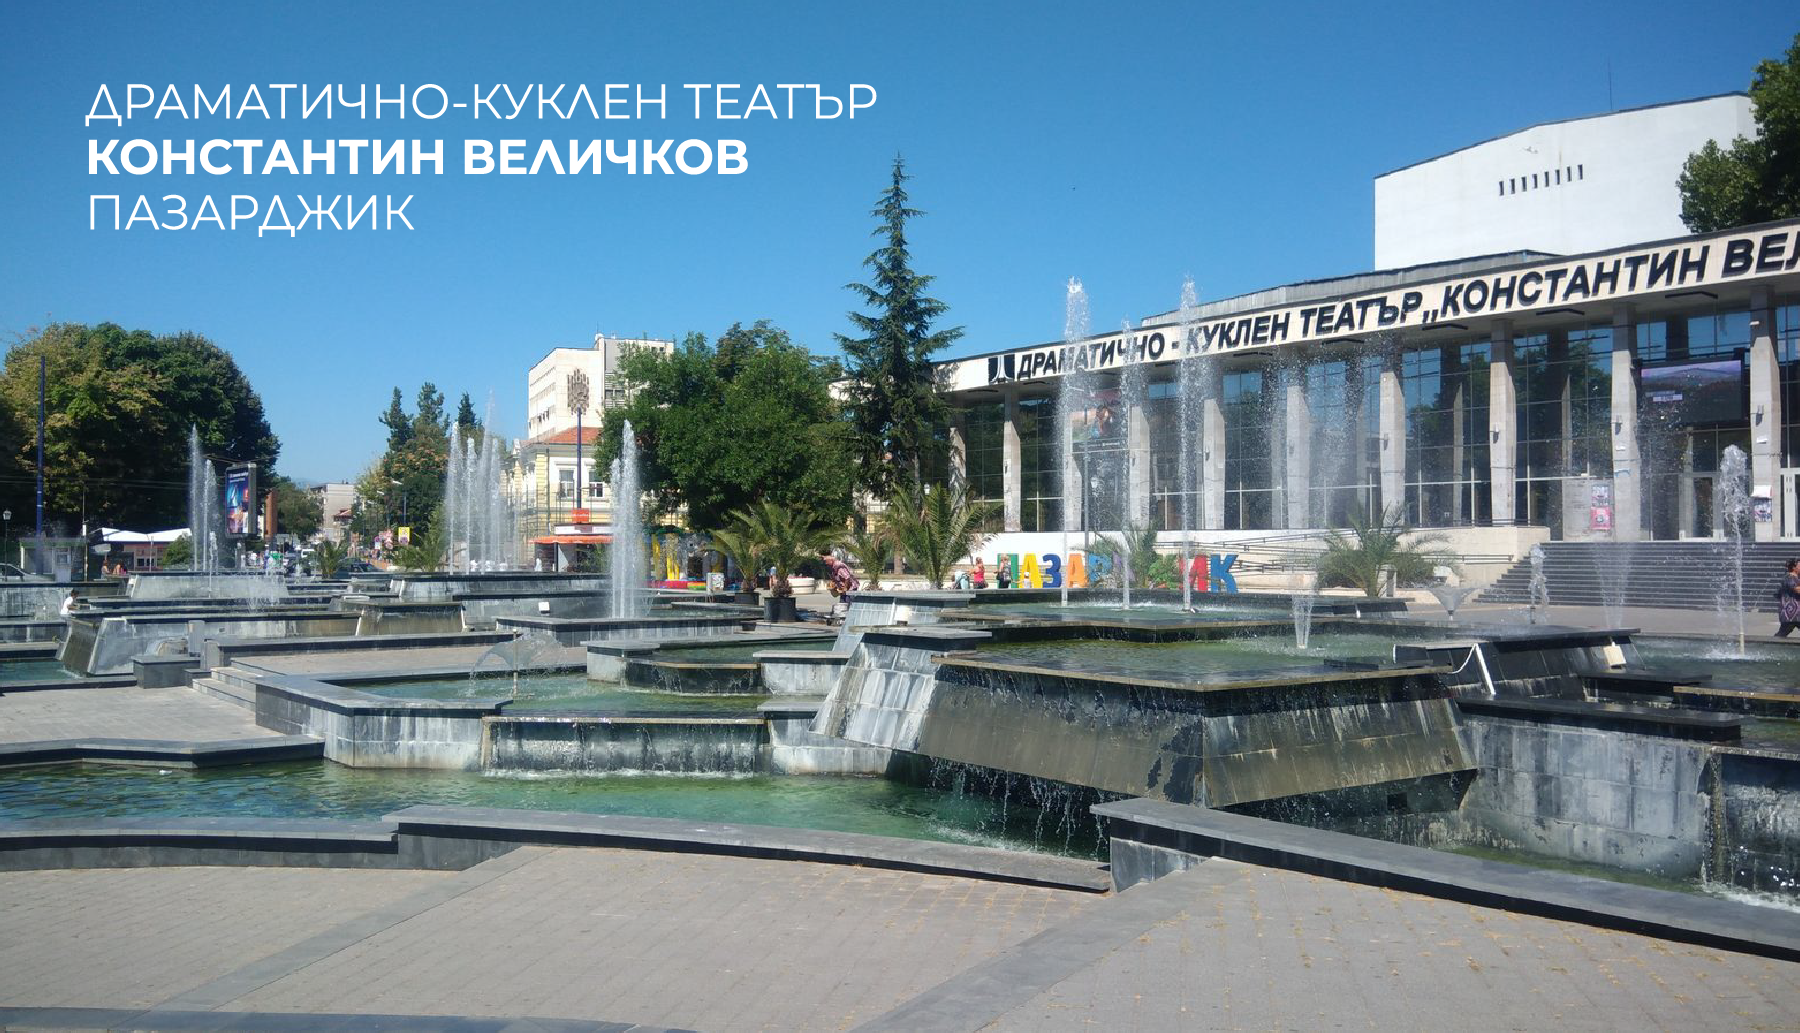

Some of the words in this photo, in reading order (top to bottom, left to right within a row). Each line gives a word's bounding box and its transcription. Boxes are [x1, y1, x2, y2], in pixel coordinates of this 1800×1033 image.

[1186, 312, 1291, 354] КУКЛЕН
[1300, 290, 1424, 338] ТЕАТЪР
[997, 551, 1239, 594] ПАЗАРИК
